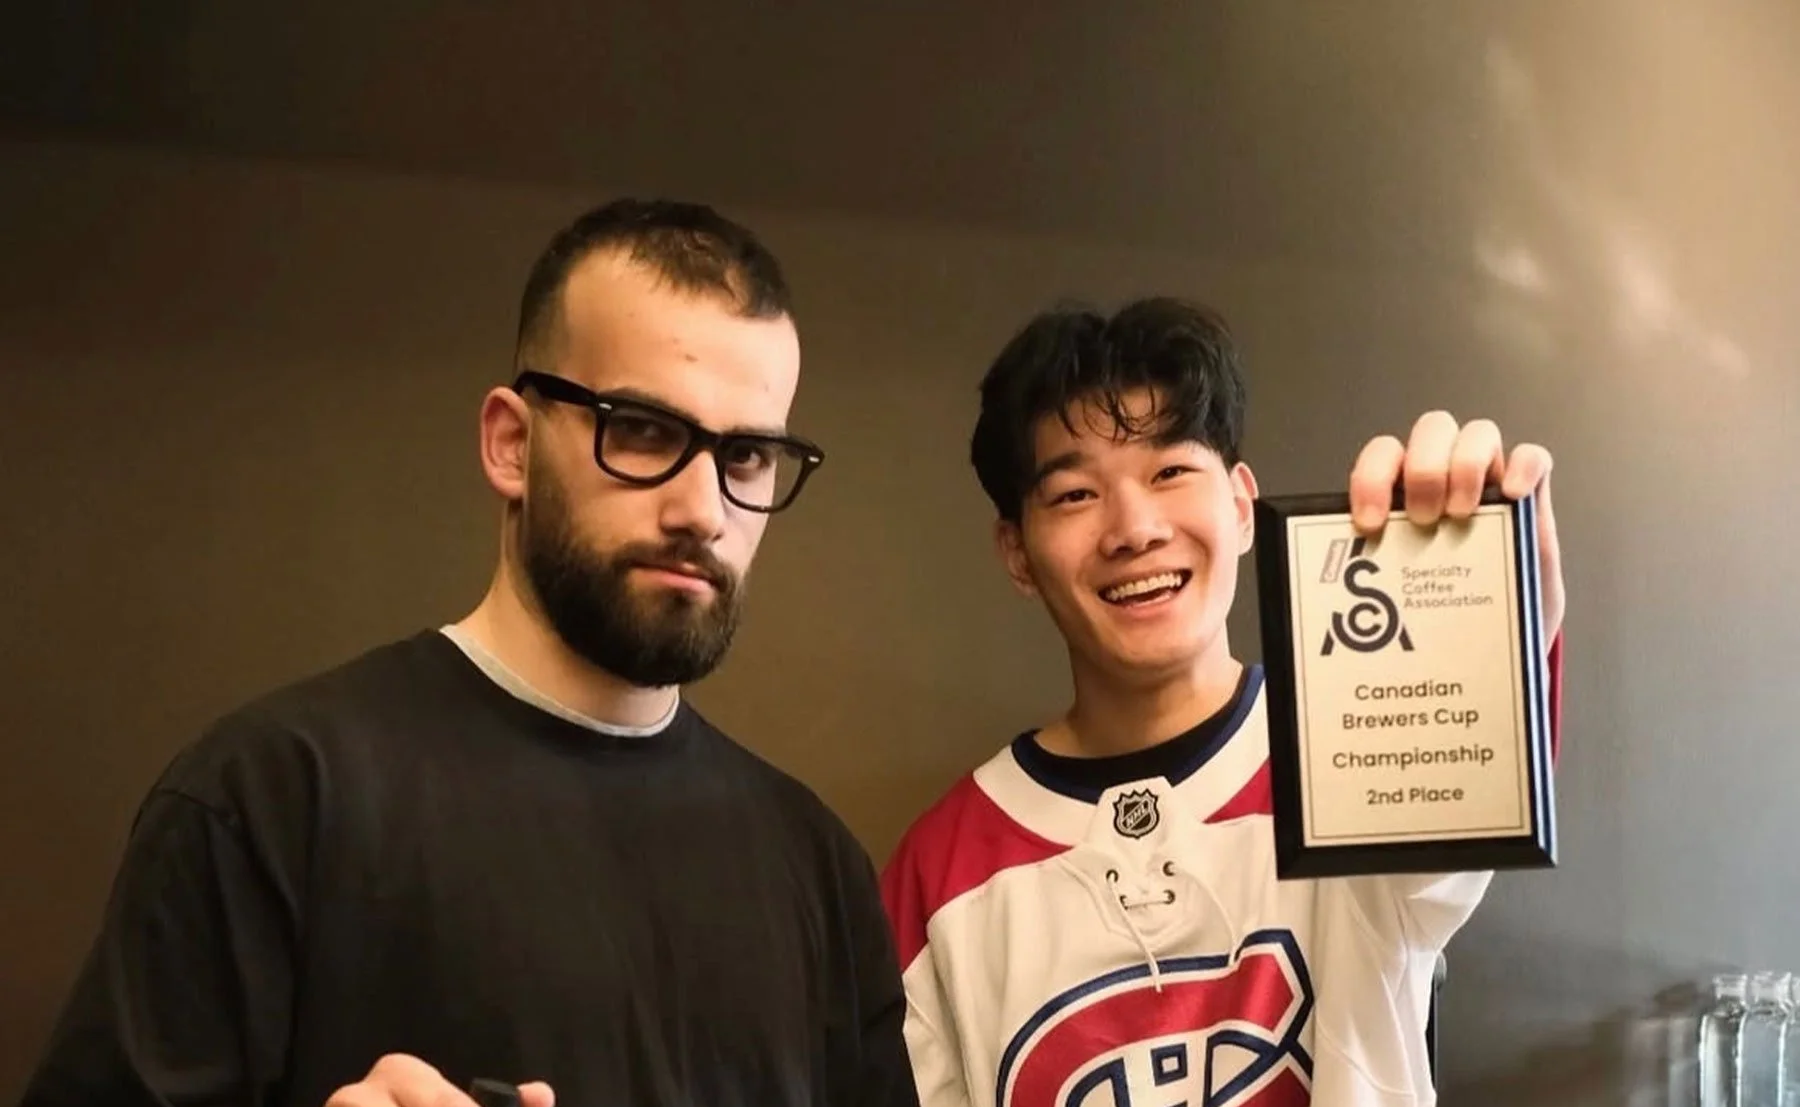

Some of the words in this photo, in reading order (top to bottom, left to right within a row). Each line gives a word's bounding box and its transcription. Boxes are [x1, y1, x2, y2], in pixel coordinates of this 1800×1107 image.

[1402, 564, 1471, 580] Specialty
[1402, 580, 1454, 596] Coffee
[1403, 594, 1493, 609] Association
[1355, 680, 1463, 701] Canadian
[1342, 710, 1429, 730] Brewers
[1434, 708, 1479, 728] Cup
[1332, 743, 1494, 771] Championship
[1366, 788, 1403, 805] 2nd
[1409, 785, 1464, 803] Place
